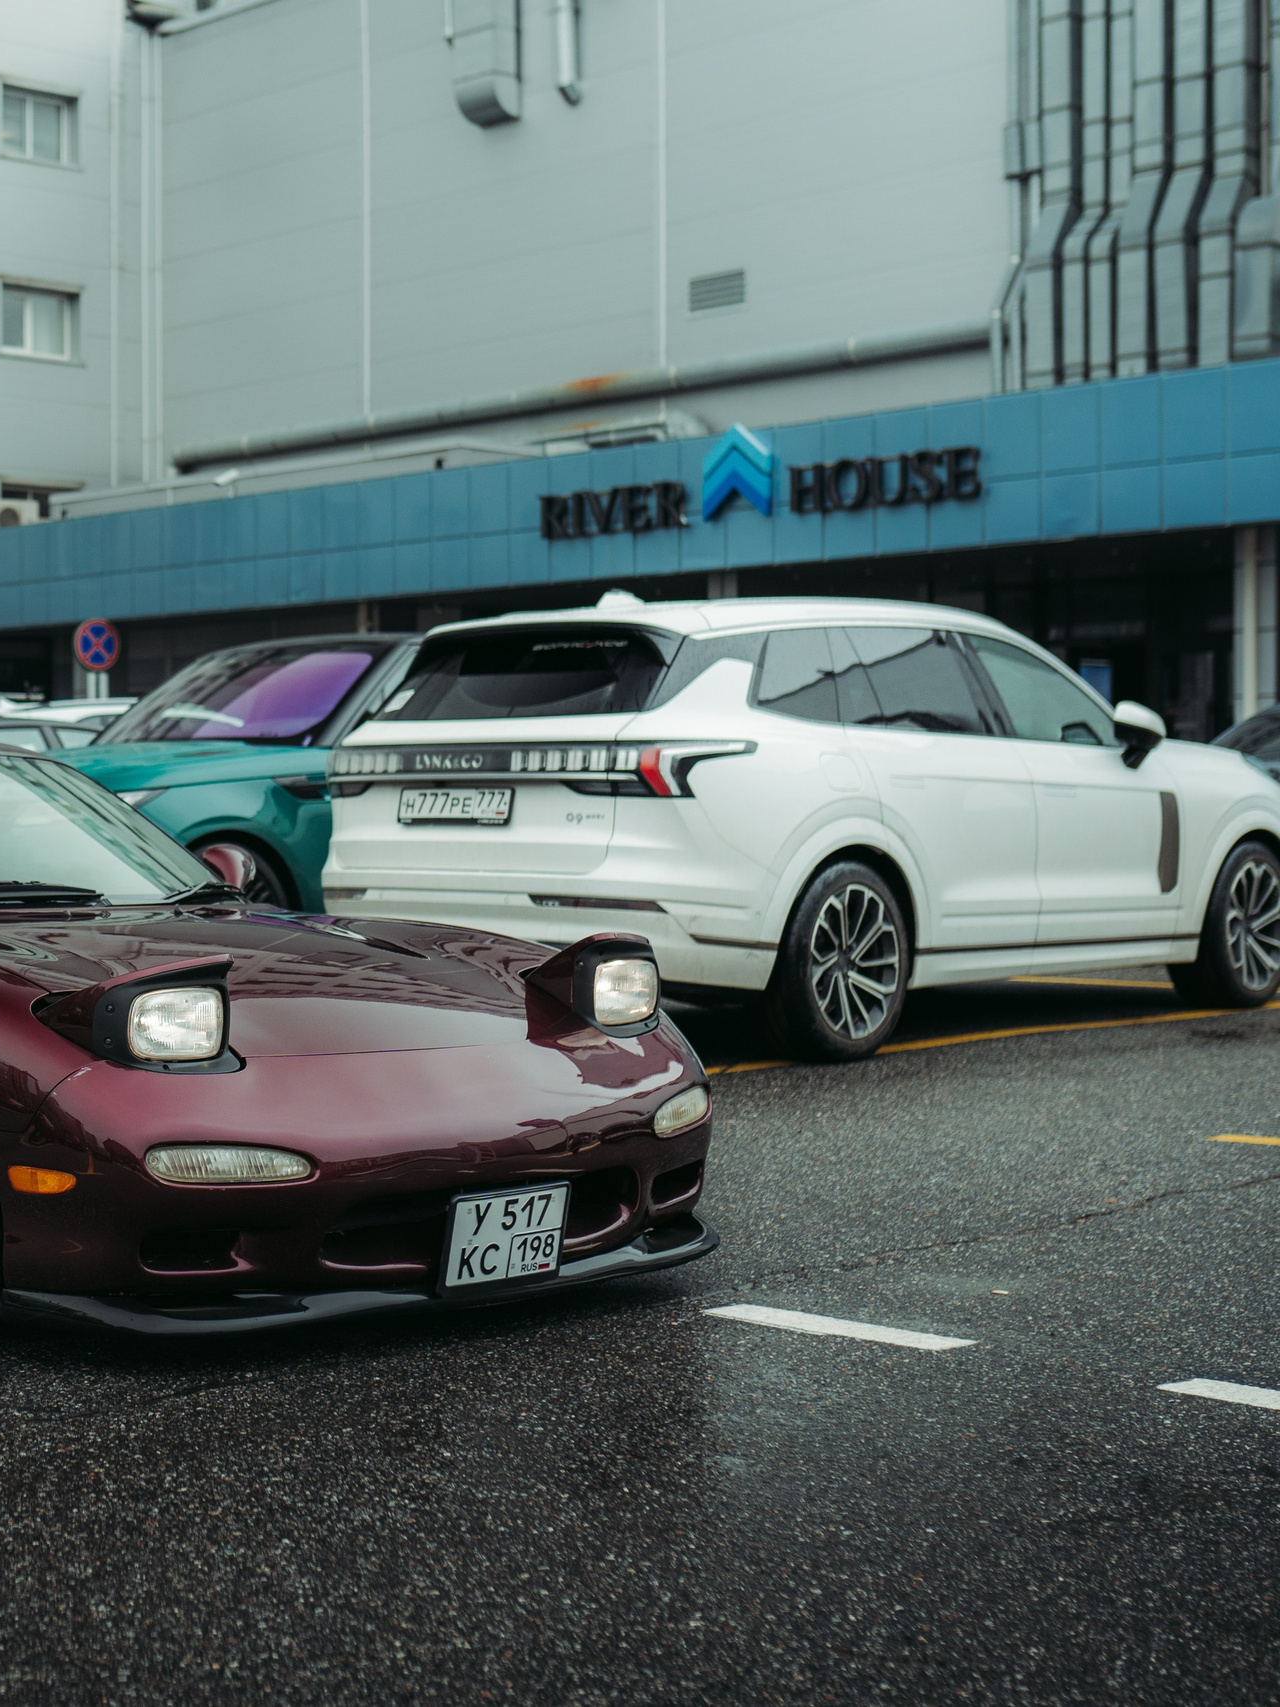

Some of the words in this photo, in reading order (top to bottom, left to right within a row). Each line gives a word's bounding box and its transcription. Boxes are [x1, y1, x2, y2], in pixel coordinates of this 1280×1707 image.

[539, 480, 690, 540] RIVER
[788, 445, 983, 516] HOUSE
[501, 1193, 552, 1230] 517
[517, 1233, 555, 1262] 198
[520, 1262, 538, 1273] RUS
